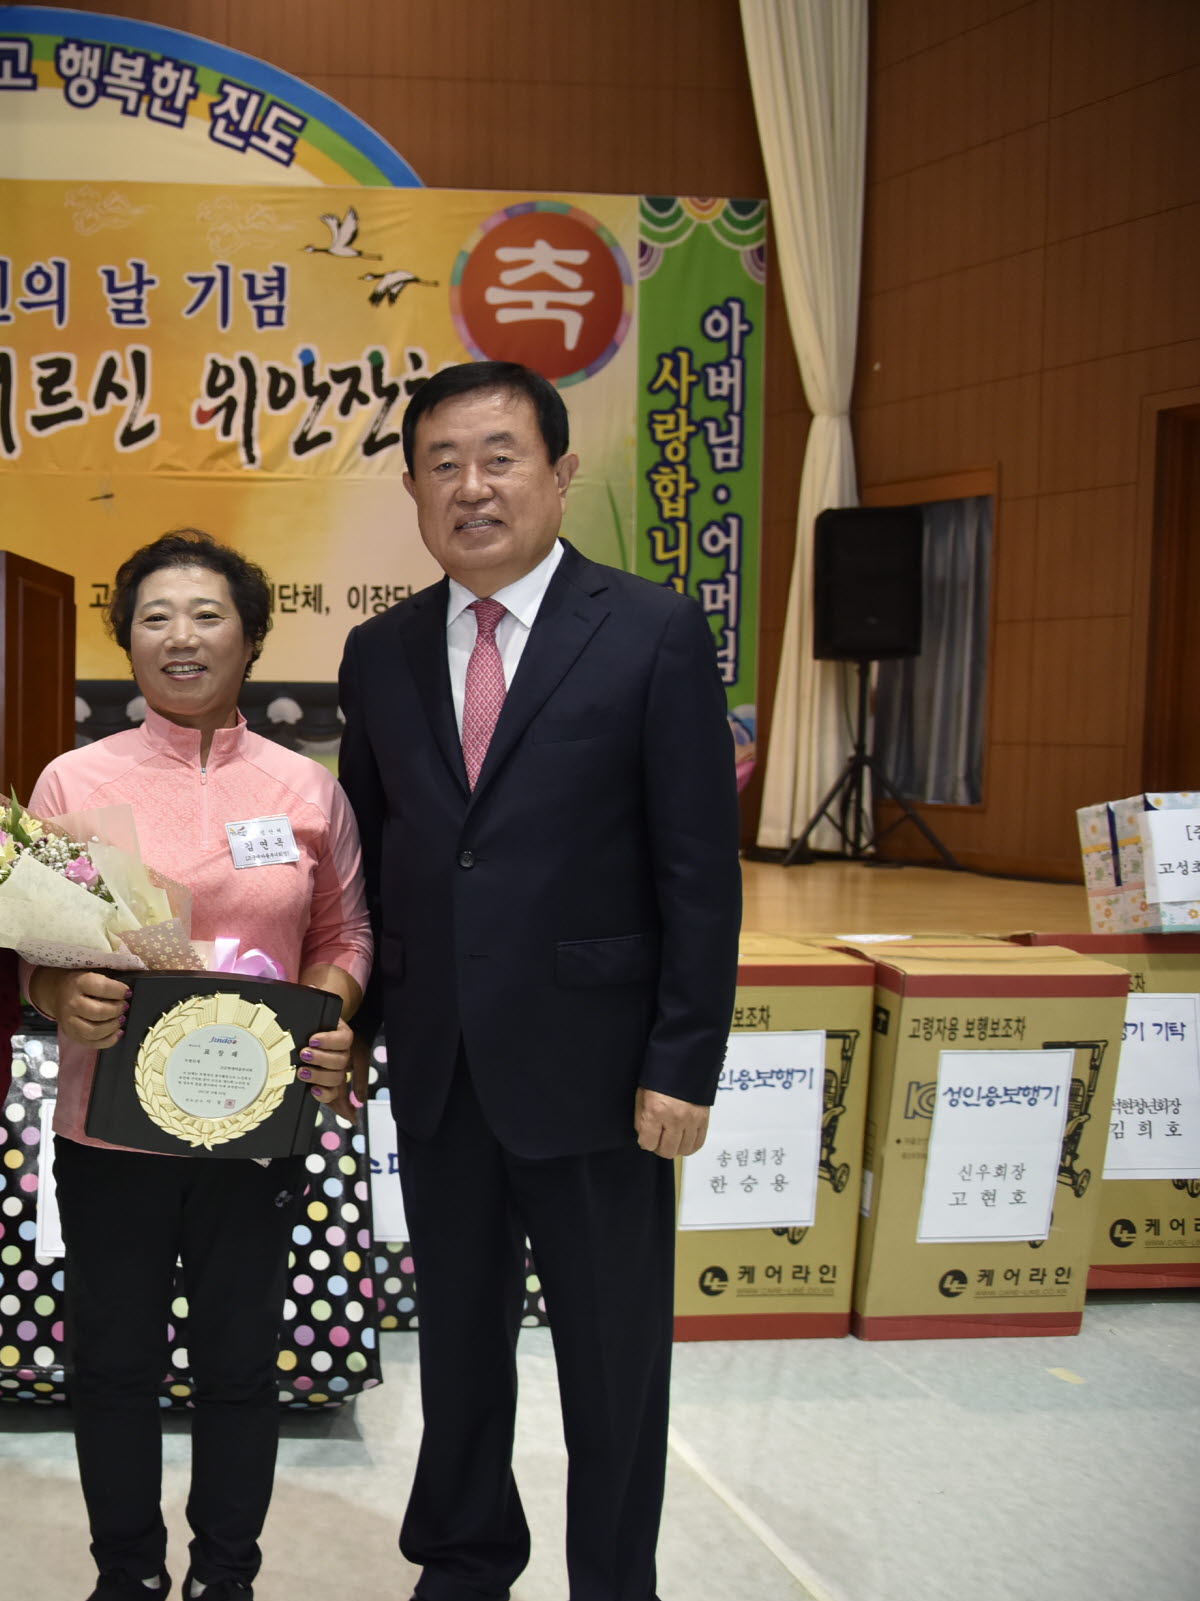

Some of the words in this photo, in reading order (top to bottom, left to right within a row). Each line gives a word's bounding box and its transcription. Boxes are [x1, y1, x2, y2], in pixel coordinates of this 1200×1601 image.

[56, 39, 199, 127] 행복한
[209, 78, 307, 166] 진도
[101, 261, 156, 326] 날
[185, 264, 288, 328] 기념
[485, 239, 595, 351] 축
[270, 583, 331, 616] 단체,
[908, 1016, 959, 1042] 고령자용
[963, 1015, 1027, 1042] 보행보조차
[1151, 1021, 1187, 1042] 기탁
[942, 1084, 1061, 1108] 성인용보행기
[957, 1162, 1027, 1183] 신우회장
